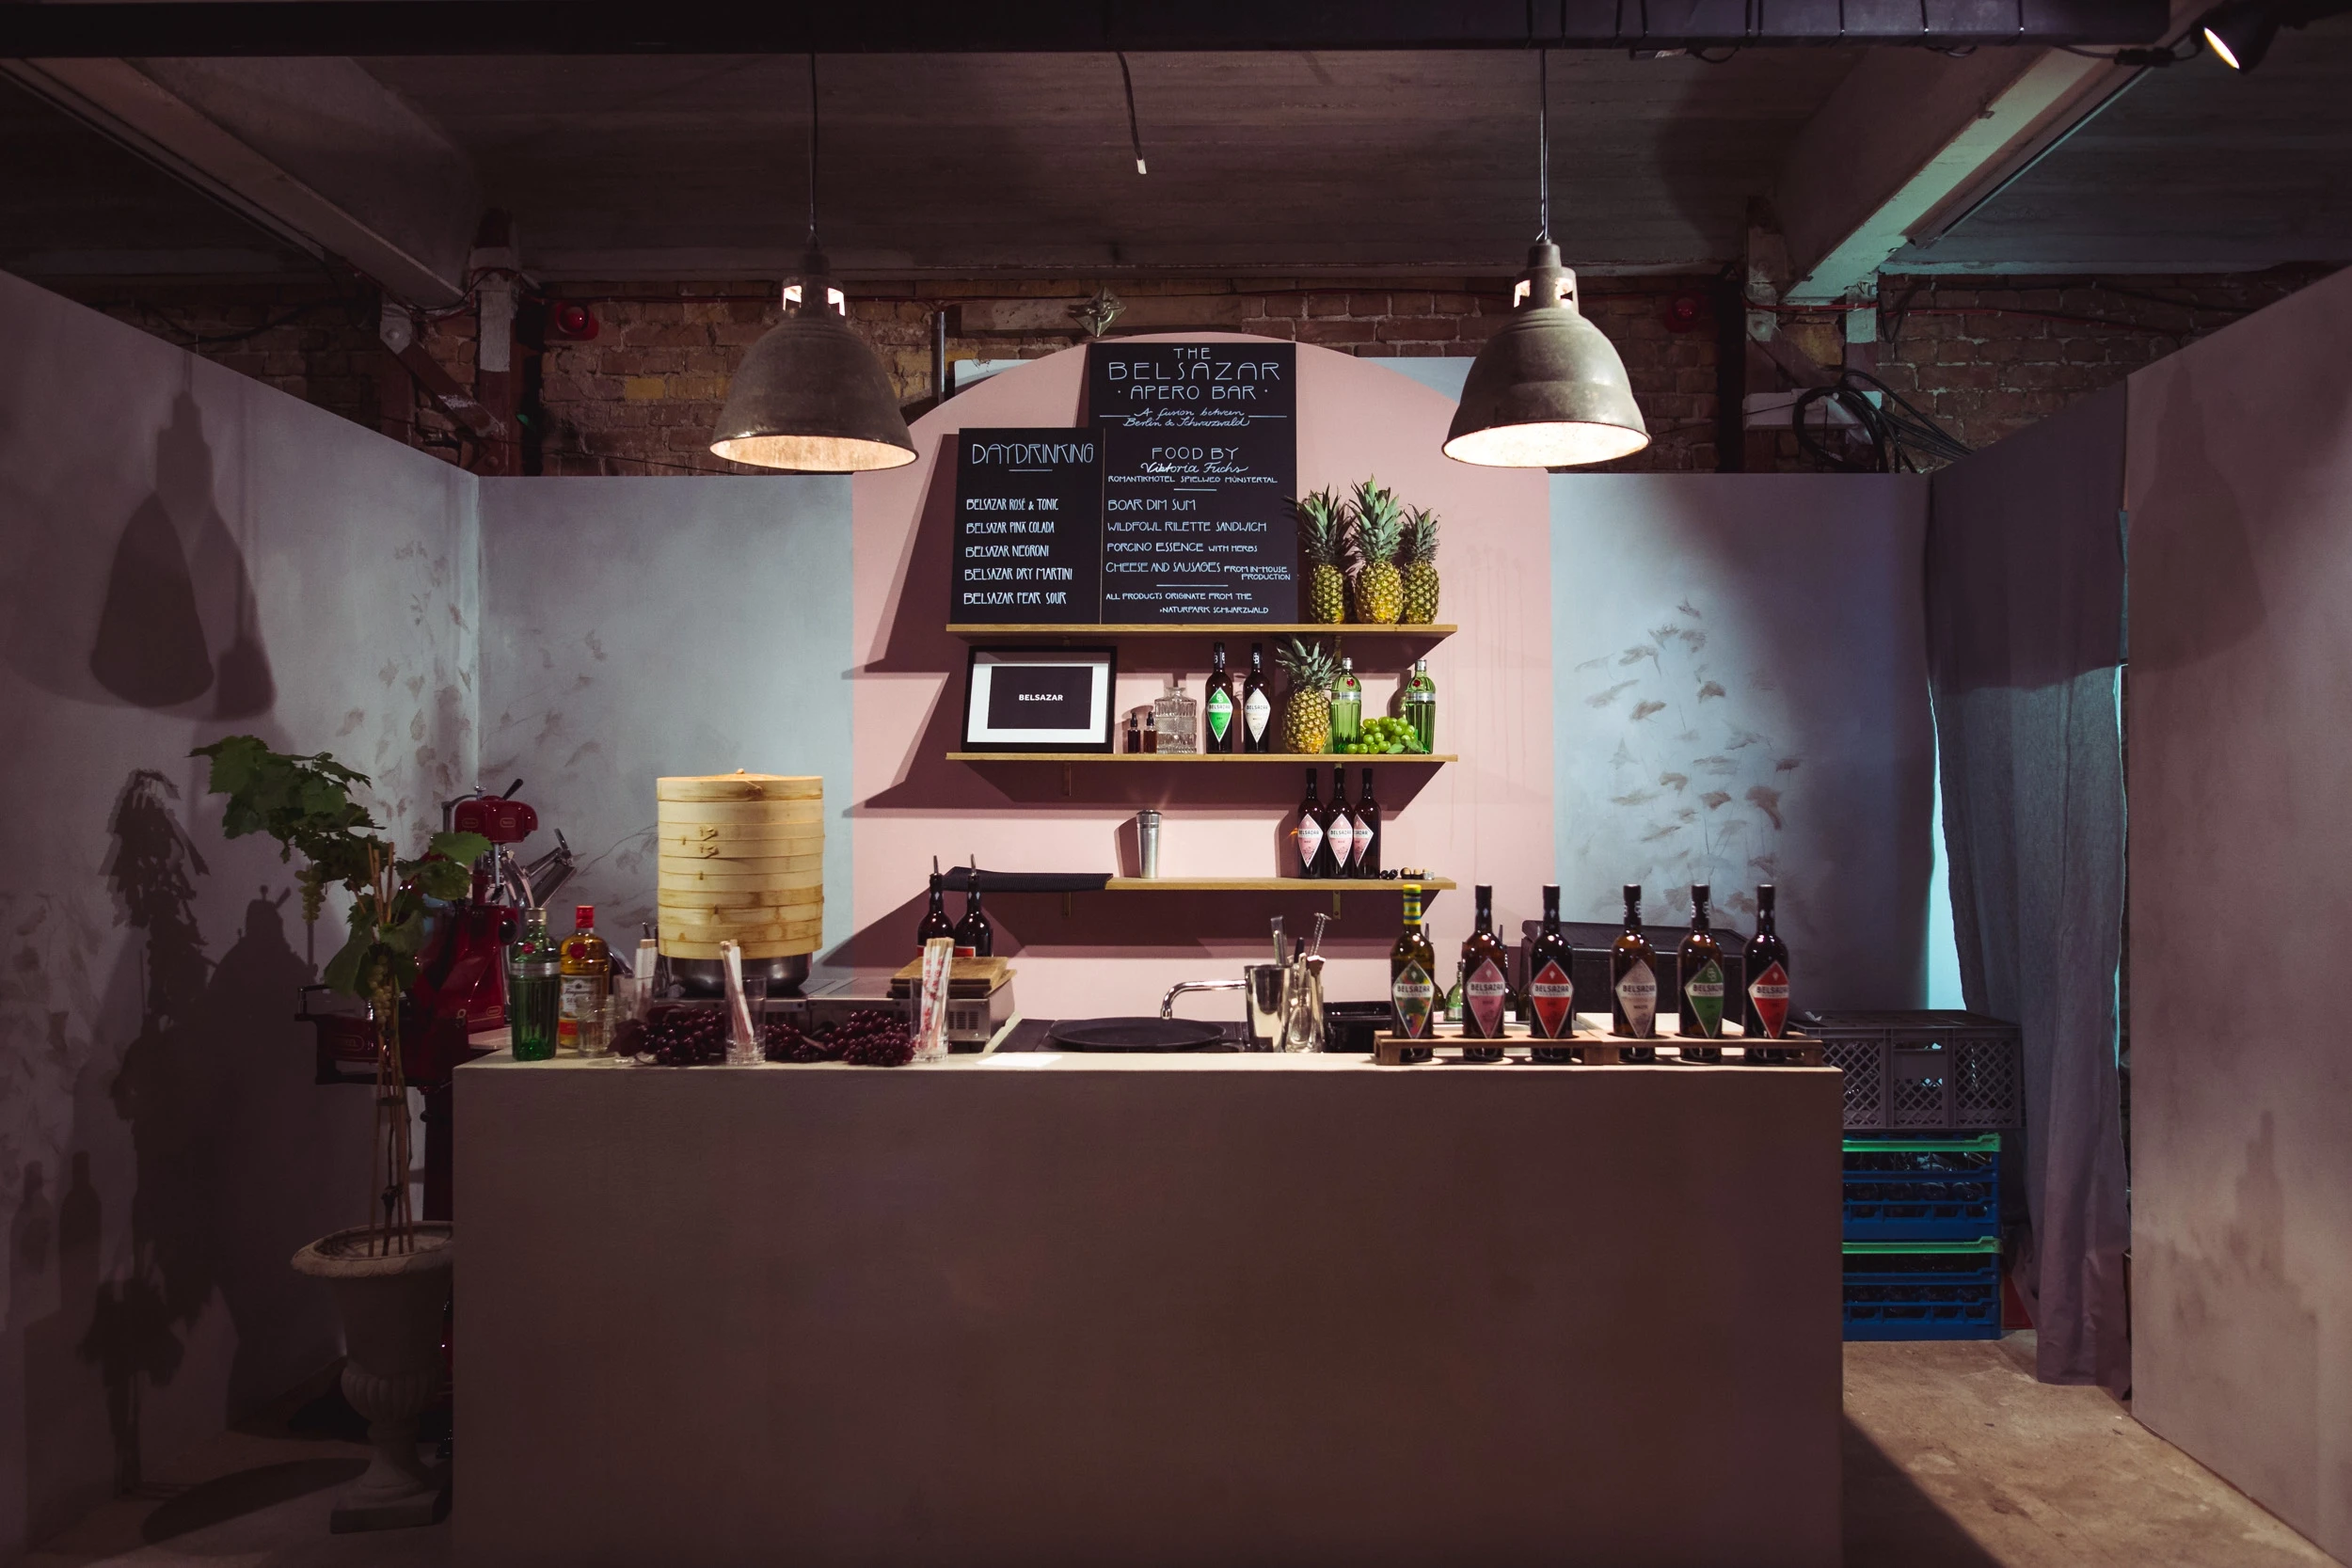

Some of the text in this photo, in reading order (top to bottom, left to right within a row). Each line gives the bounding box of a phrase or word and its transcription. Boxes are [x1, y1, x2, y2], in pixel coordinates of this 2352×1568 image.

[1173, 347, 1211, 359] THE
[1108, 362, 1279, 380] BELSAZAR
[1130, 386, 1256, 400] APERO BAR
[1155, 408, 1194, 420] fusion
[1200, 407, 1245, 417] between
[1122, 415, 1250, 427] Berlin & Schwarzwald
[972, 443, 1094, 465] DAYDRINKING
[1152, 447, 1239, 460] FOOD BY
[1203, 461, 1249, 473] Fuchs
[966, 498, 1059, 511] BELSAZAR ROSÉ & TONIC
[1107, 499, 1196, 511] BOAR DIM SUM
[966, 522, 1008, 533] BELSAZAR
[1028, 521, 1055, 533] COLADA
[1107, 521, 1267, 532] WILDFOWL RILETTE SANDWICH
[965, 545, 1049, 558] BELSAZAR NEGRONI
[1106, 543, 1152, 552] PORCINO
[1155, 543, 1204, 552] ESSENCE
[964, 567, 1073, 580] BELSAZAR DRY MARTINI
[1105, 562, 1149, 573] CHEESE
[1151, 562, 1170, 573] AND
[1173, 562, 1221, 573] SAUSAGES
[963, 592, 1067, 604] BELSAZAR PEAR SOUR
